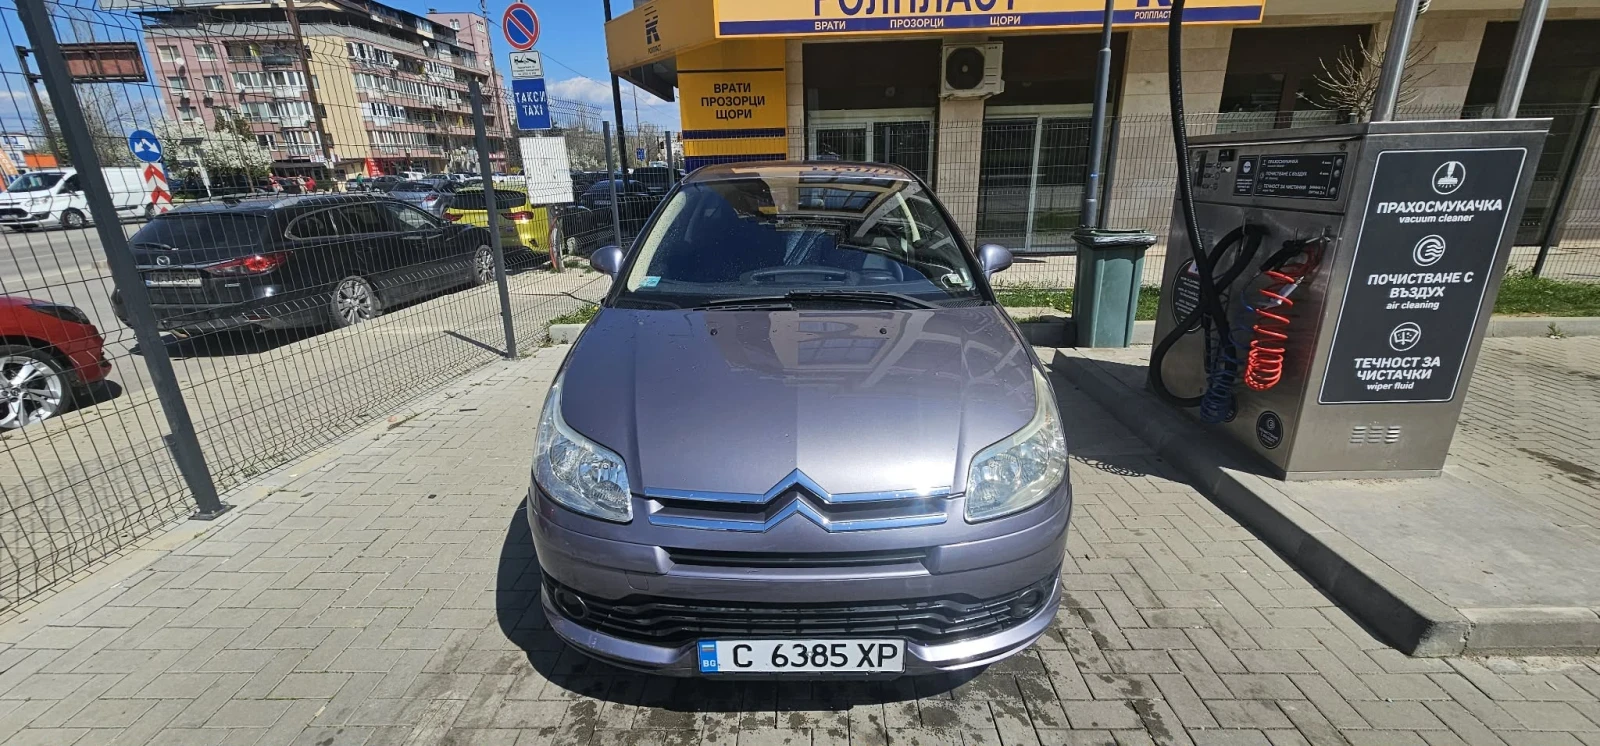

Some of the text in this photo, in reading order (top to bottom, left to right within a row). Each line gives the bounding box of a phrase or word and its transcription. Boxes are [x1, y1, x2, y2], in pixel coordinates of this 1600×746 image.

[814, 15, 1021, 31] ВРАТИ ПРОЗОРЦИ ЩОРИ
[713, 82, 751, 94] ВРАТИ
[514, 91, 547, 104] ТАКСИ
[701, 95, 765, 107] ПРОЗОРЦИ
[522, 104, 543, 116] TAXI
[715, 109, 752, 121] ЩОРИ
[1377, 199, 1503, 214] ПРАХОСМУКАЧКА
[1399, 213, 1474, 224] vacuum cleaner
[1367, 271, 1474, 285] ПОЧИСТВАНЕ С
[1389, 286, 1446, 300] ВЪЗДУХ
[1386, 300, 1440, 311] air cleaning
[1354, 356, 1441, 369] ТЕЧНОСТ ЗА
[1357, 368, 1433, 381] ЧИСТАЧКИ
[1366, 381, 1415, 392] wiper fluid
[732, 643, 898, 668] C 6385 XP
[702, 660, 717, 668] BG
